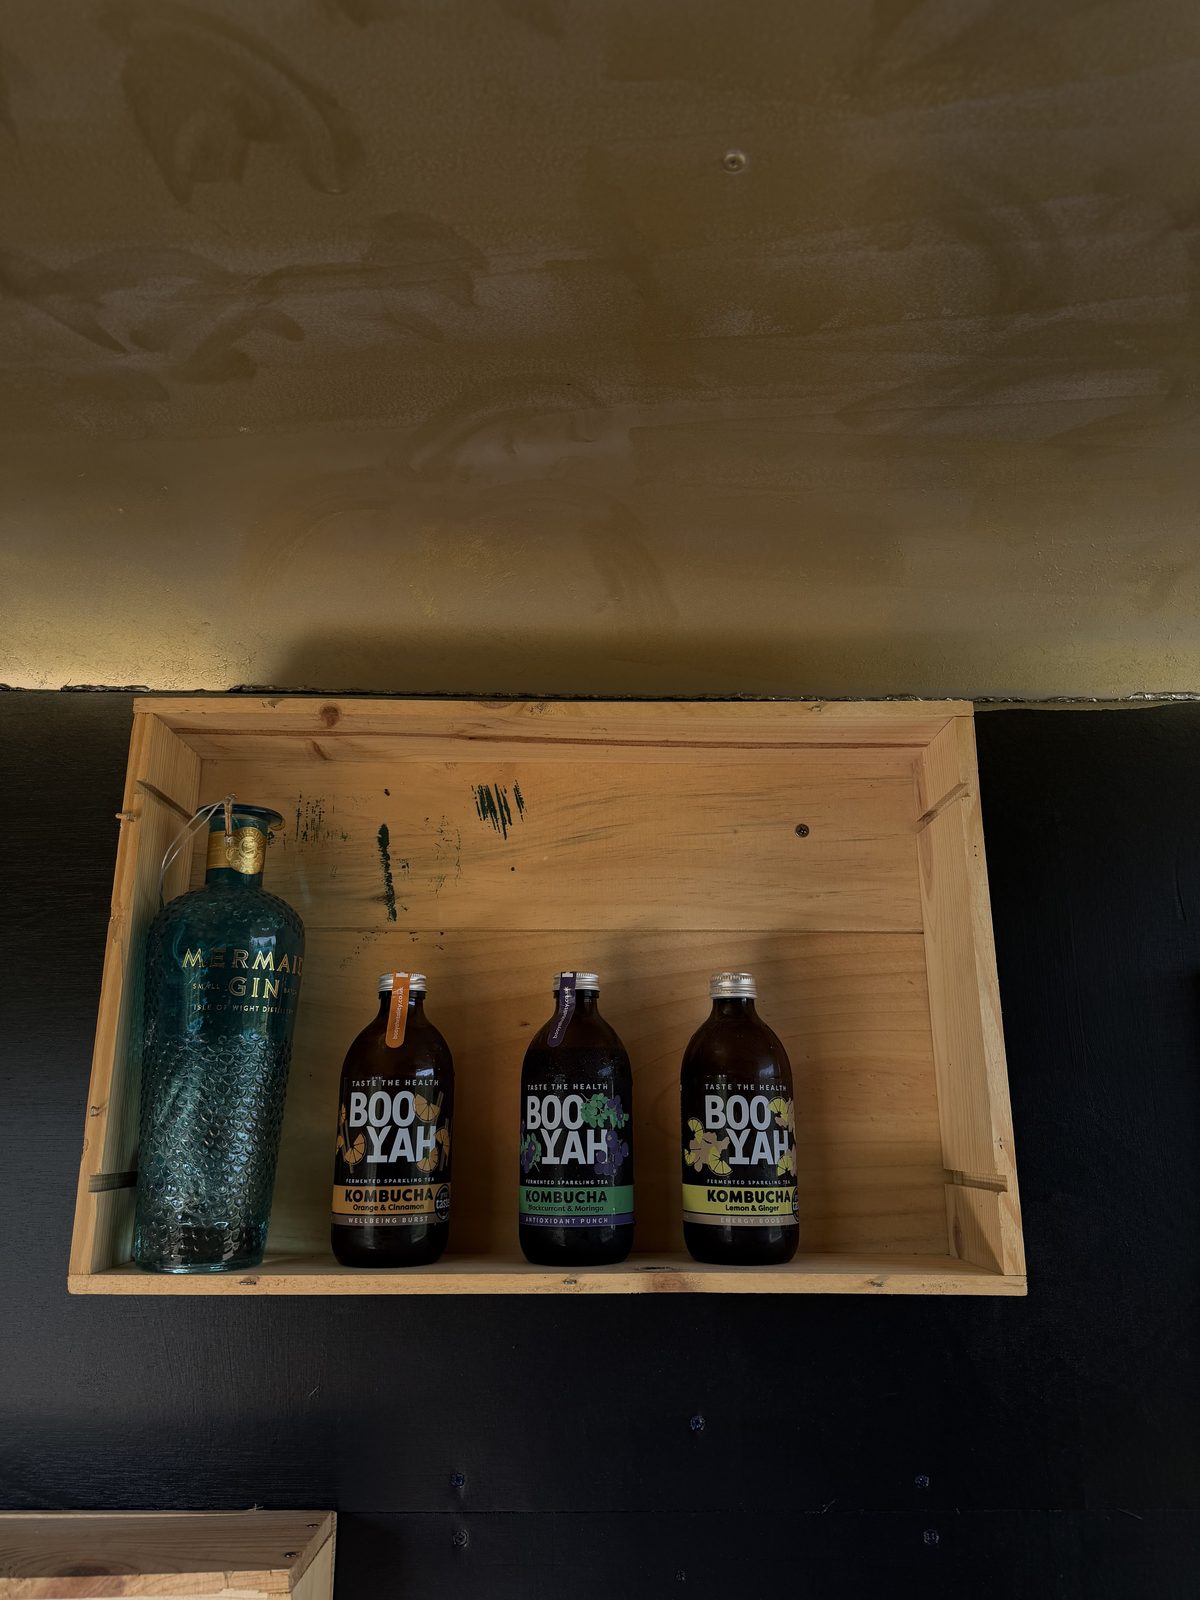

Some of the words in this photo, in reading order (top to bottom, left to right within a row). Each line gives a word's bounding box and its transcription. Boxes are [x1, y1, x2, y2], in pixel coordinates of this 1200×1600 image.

[228, 976, 280, 999] GIN
[232, 1004, 259, 1013] WIGHT
[352, 1079, 377, 1087] TASTE
[382, 1079, 400, 1087] THE
[705, 1083, 732, 1091] TASTE
[737, 1083, 755, 1091] THE
[759, 1084, 787, 1092] HEALTH
[349, 1090, 416, 1128] BOO
[527, 1094, 586, 1130] BOO
[704, 1094, 772, 1131] BOO
[366, 1125, 437, 1163] YAH
[540, 1128, 609, 1165] YAH
[725, 1128, 789, 1165] YAH
[344, 1188, 434, 1203] KOMBUCHA
[525, 1189, 608, 1204] KOMBUCHA
[707, 1189, 791, 1203] KOMBUCHA
[352, 1204, 379, 1212] Orange
[758, 1204, 780, 1213] Ginger
[348, 1216, 397, 1224] WELLBEING
[402, 1215, 429, 1223] BURST
